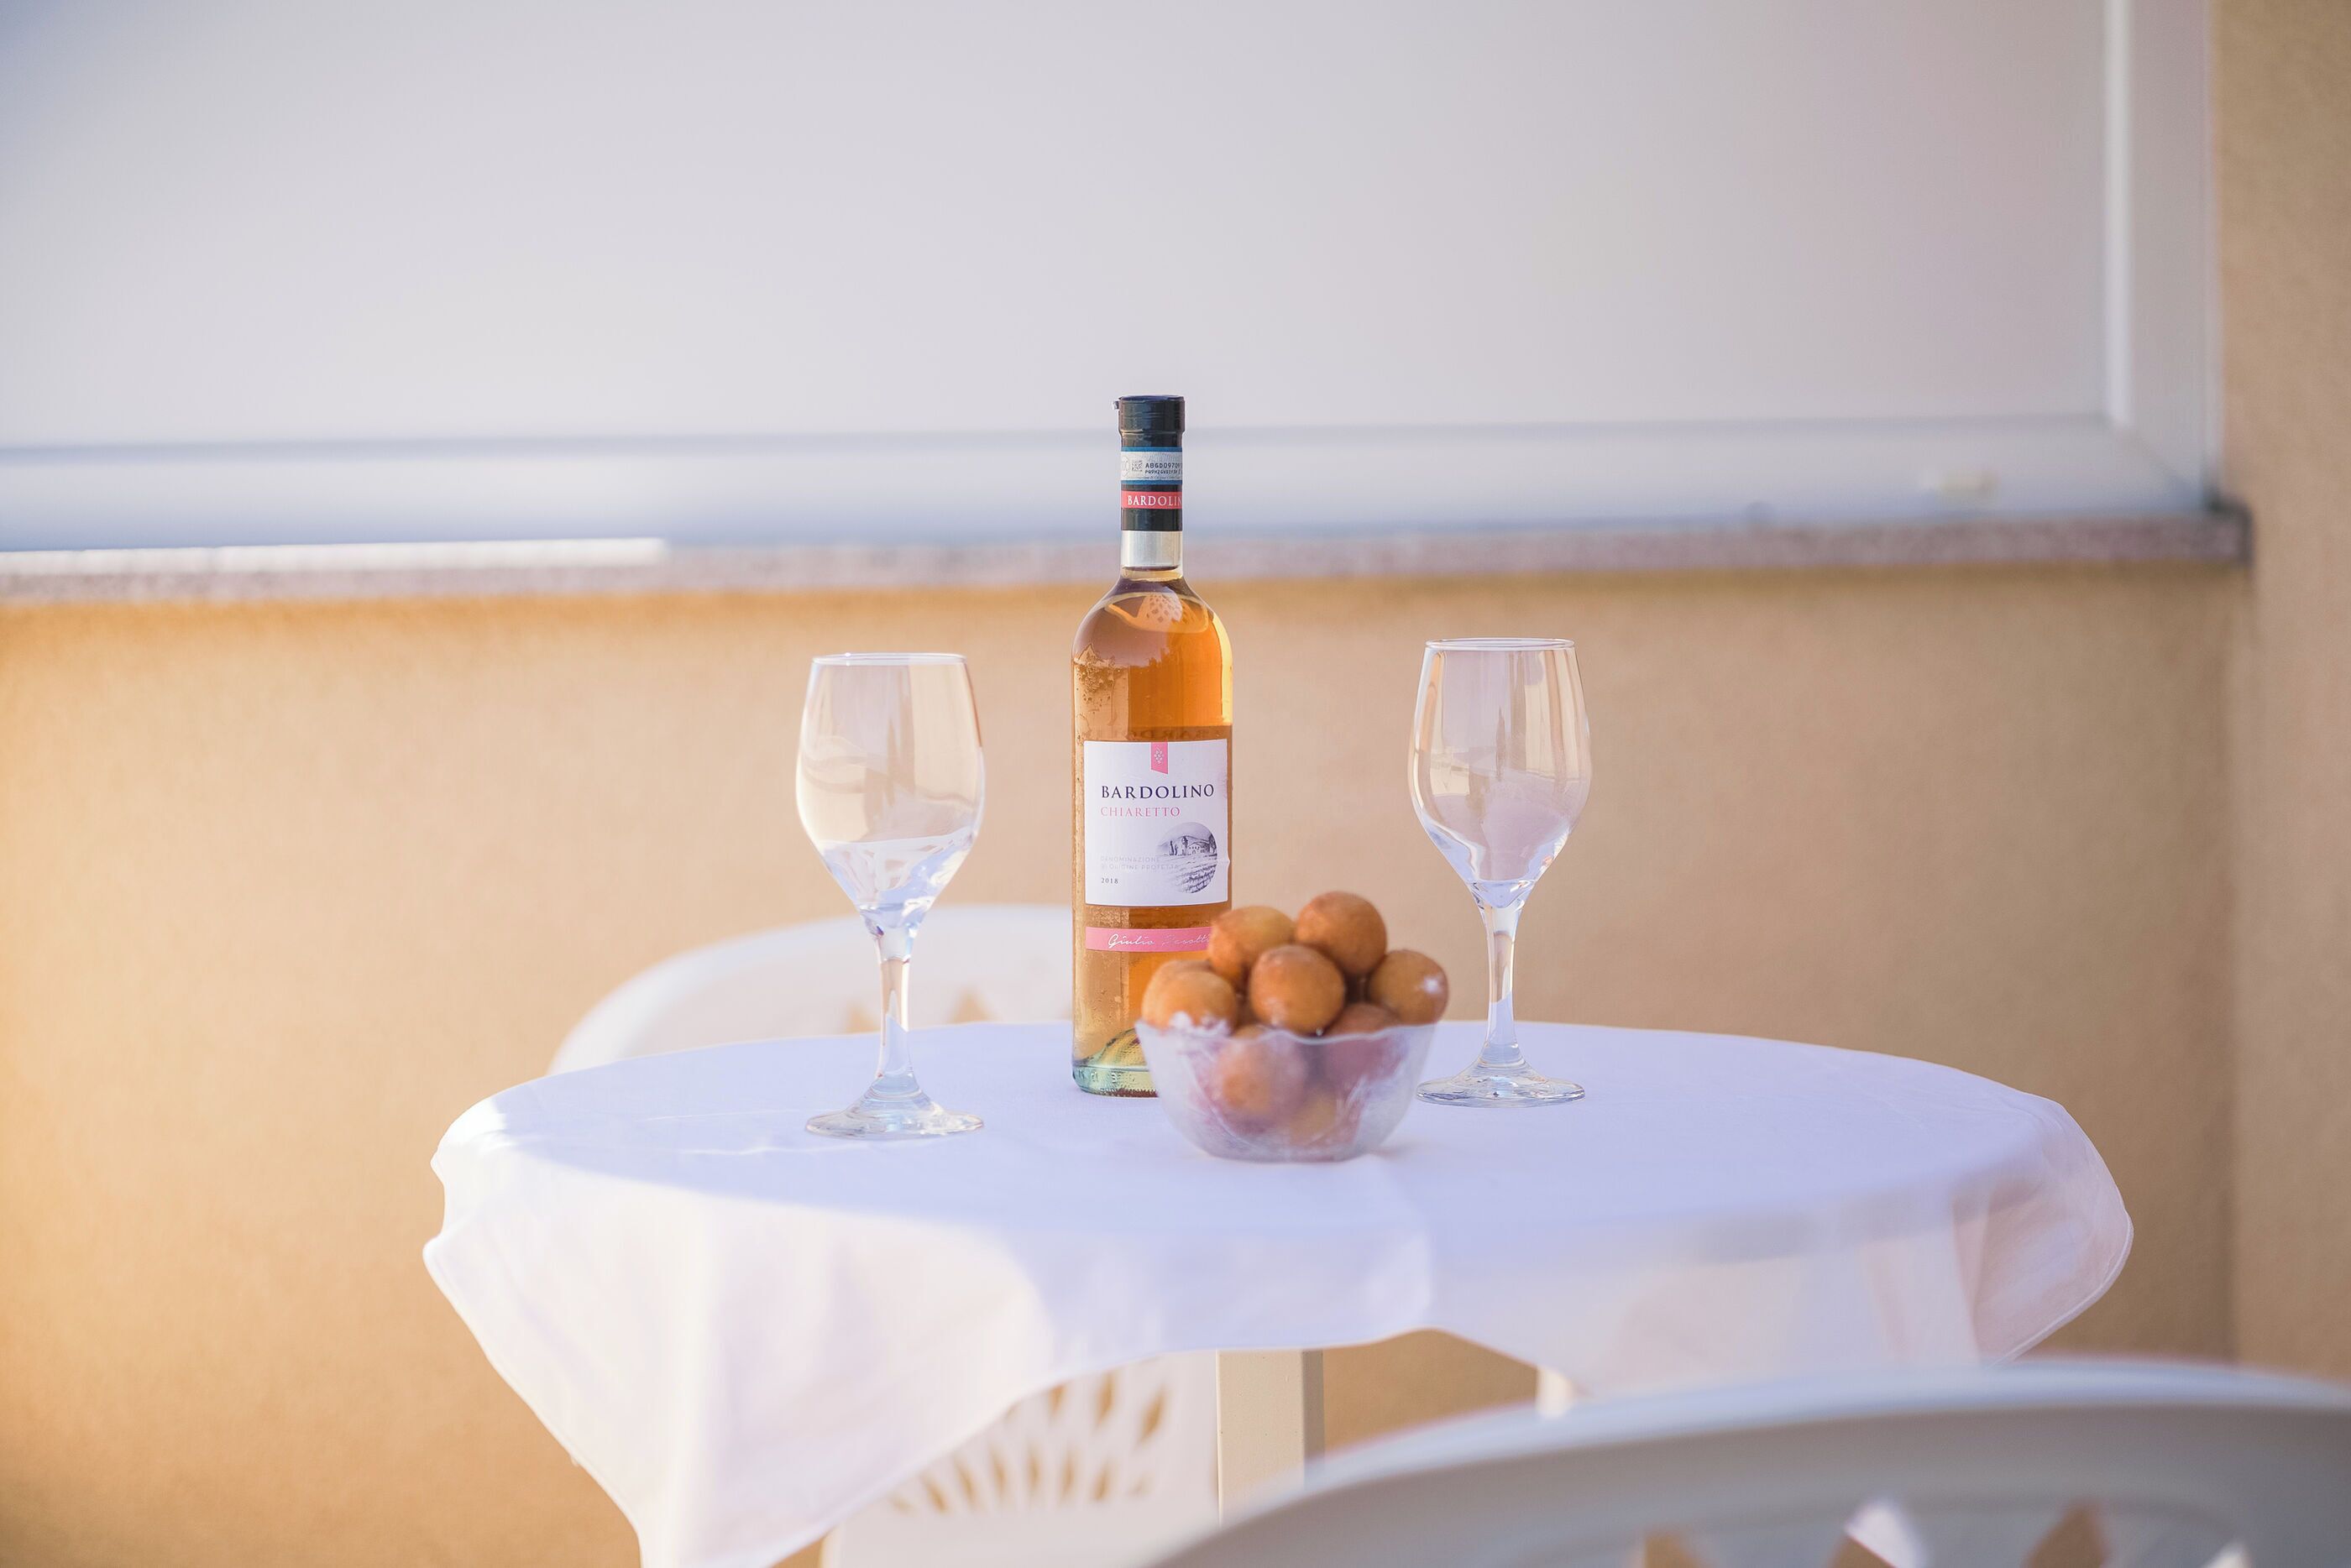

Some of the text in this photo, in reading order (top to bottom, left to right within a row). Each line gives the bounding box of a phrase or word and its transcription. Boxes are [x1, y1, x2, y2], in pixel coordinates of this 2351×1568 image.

[1102, 783, 1214, 800] BARDOLINO
[1100, 807, 1181, 818] CHIARETTO
[1107, 933, 1155, 949] Giulio
